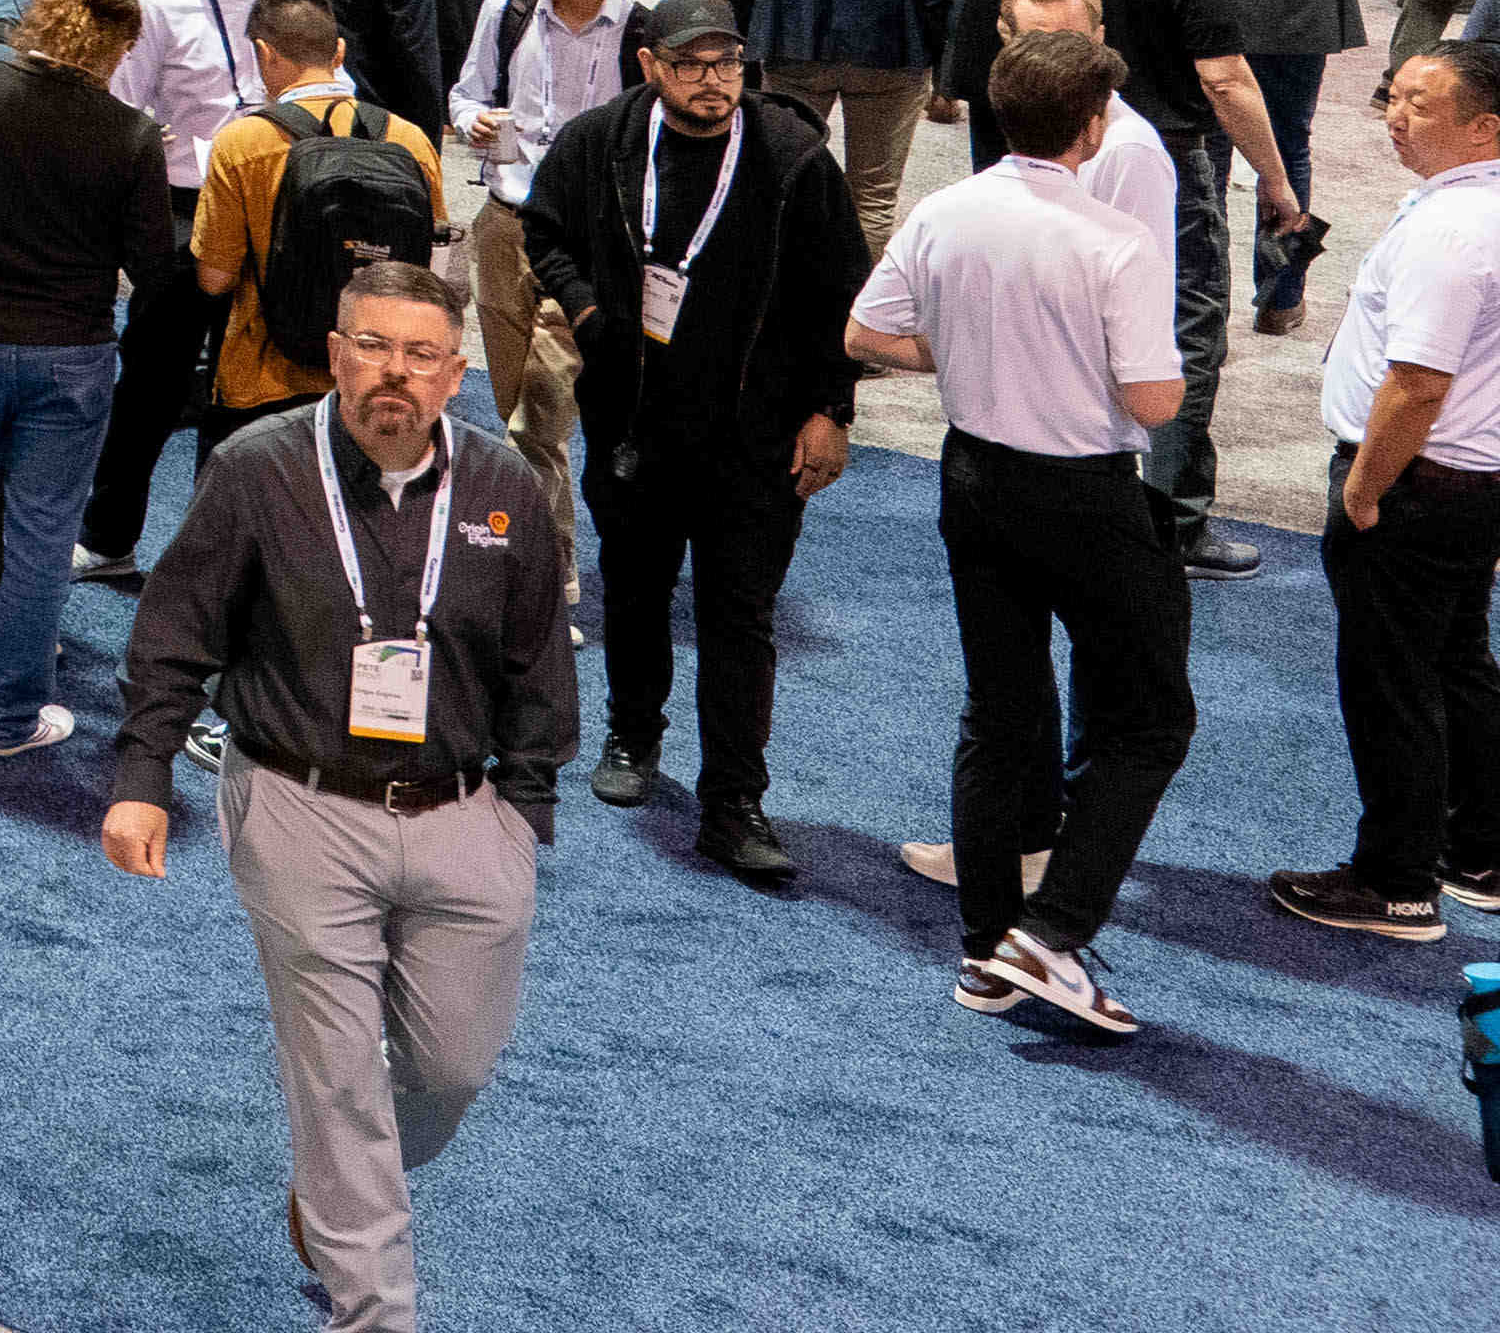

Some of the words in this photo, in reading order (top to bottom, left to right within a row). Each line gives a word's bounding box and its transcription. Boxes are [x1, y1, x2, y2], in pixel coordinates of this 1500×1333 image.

[458, 521, 490, 535] Origin
[467, 532, 509, 548] Engines
[1387, 901, 1435, 917] HOKA
